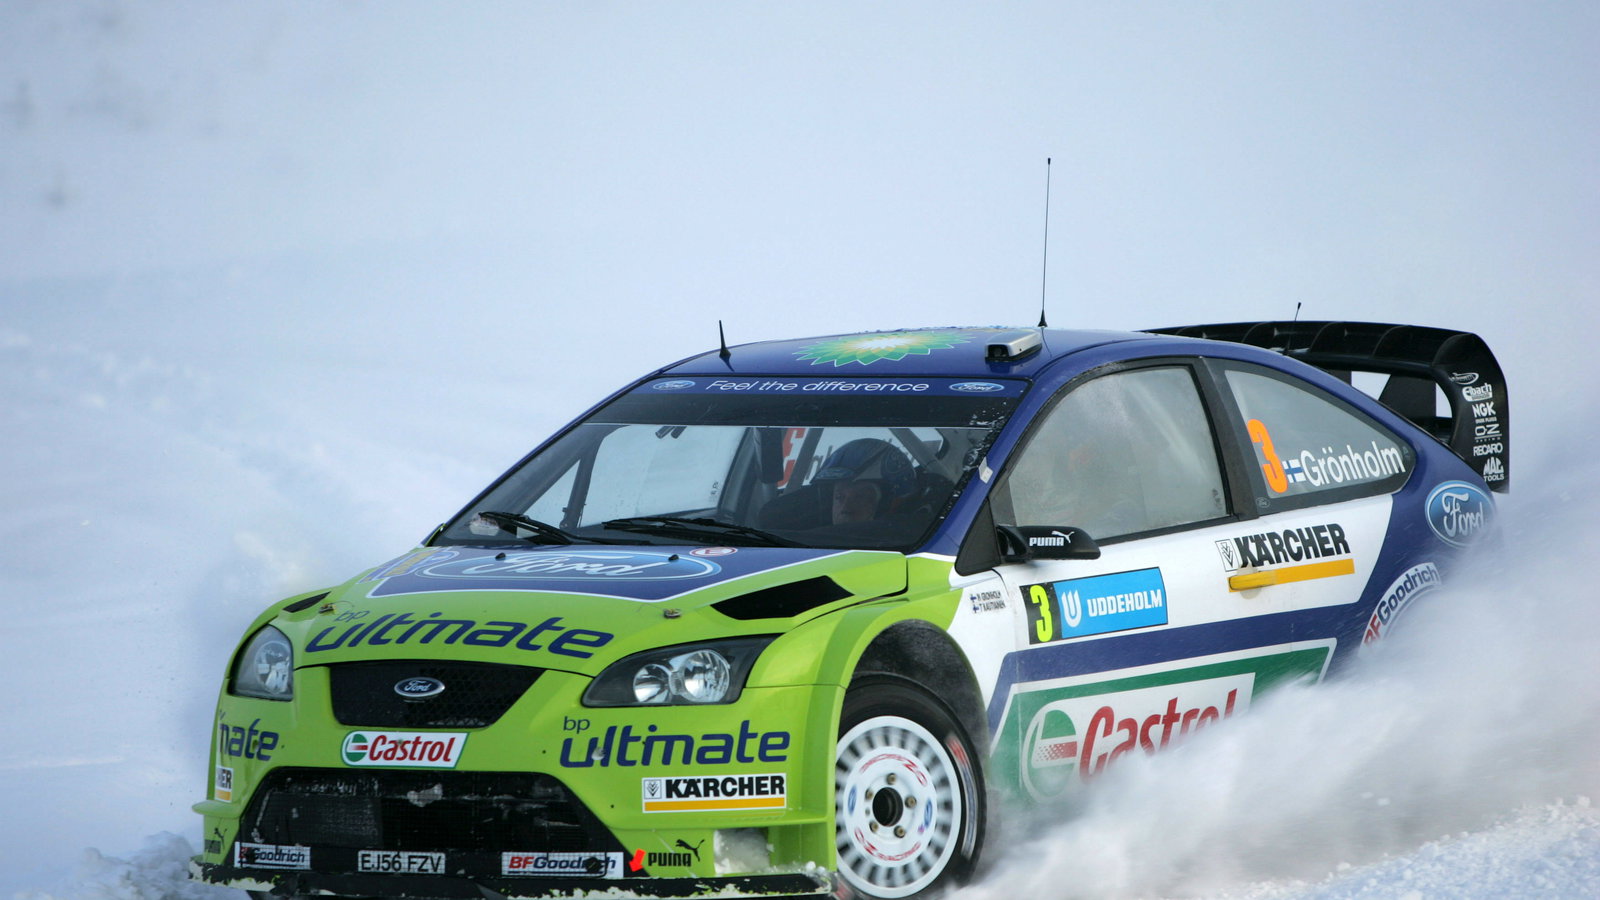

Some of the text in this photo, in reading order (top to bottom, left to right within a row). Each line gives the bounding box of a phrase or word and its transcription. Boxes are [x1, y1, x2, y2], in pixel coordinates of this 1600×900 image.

[706, 380, 930, 391] Feel the difference
[1472, 401, 1496, 418] NGK
[1247, 418, 1406, 494] 3 Grönholm
[1473, 443, 1504, 456] RECARO
[1483, 456, 1504, 475] MAC
[1484, 473, 1505, 482] TOOLS
[1441, 492, 1485, 538] Ford
[1029, 536, 1065, 547] PUMA
[1233, 523, 1351, 568] KÄRCHER
[472, 552, 666, 576] Ford
[337, 609, 369, 624] bp
[1029, 584, 1053, 643] 3
[1086, 589, 1163, 617] UDDEHOLM
[305, 611, 615, 659] ultimate
[404, 680, 432, 691] Ford
[563, 716, 590, 734] bp
[368, 734, 456, 762] Castrol
[560, 719, 790, 768] ultimate
[665, 775, 785, 799] KÄRCHER
[361, 853, 442, 872] EJ56 FZV
[648, 852, 692, 867] PUMA
